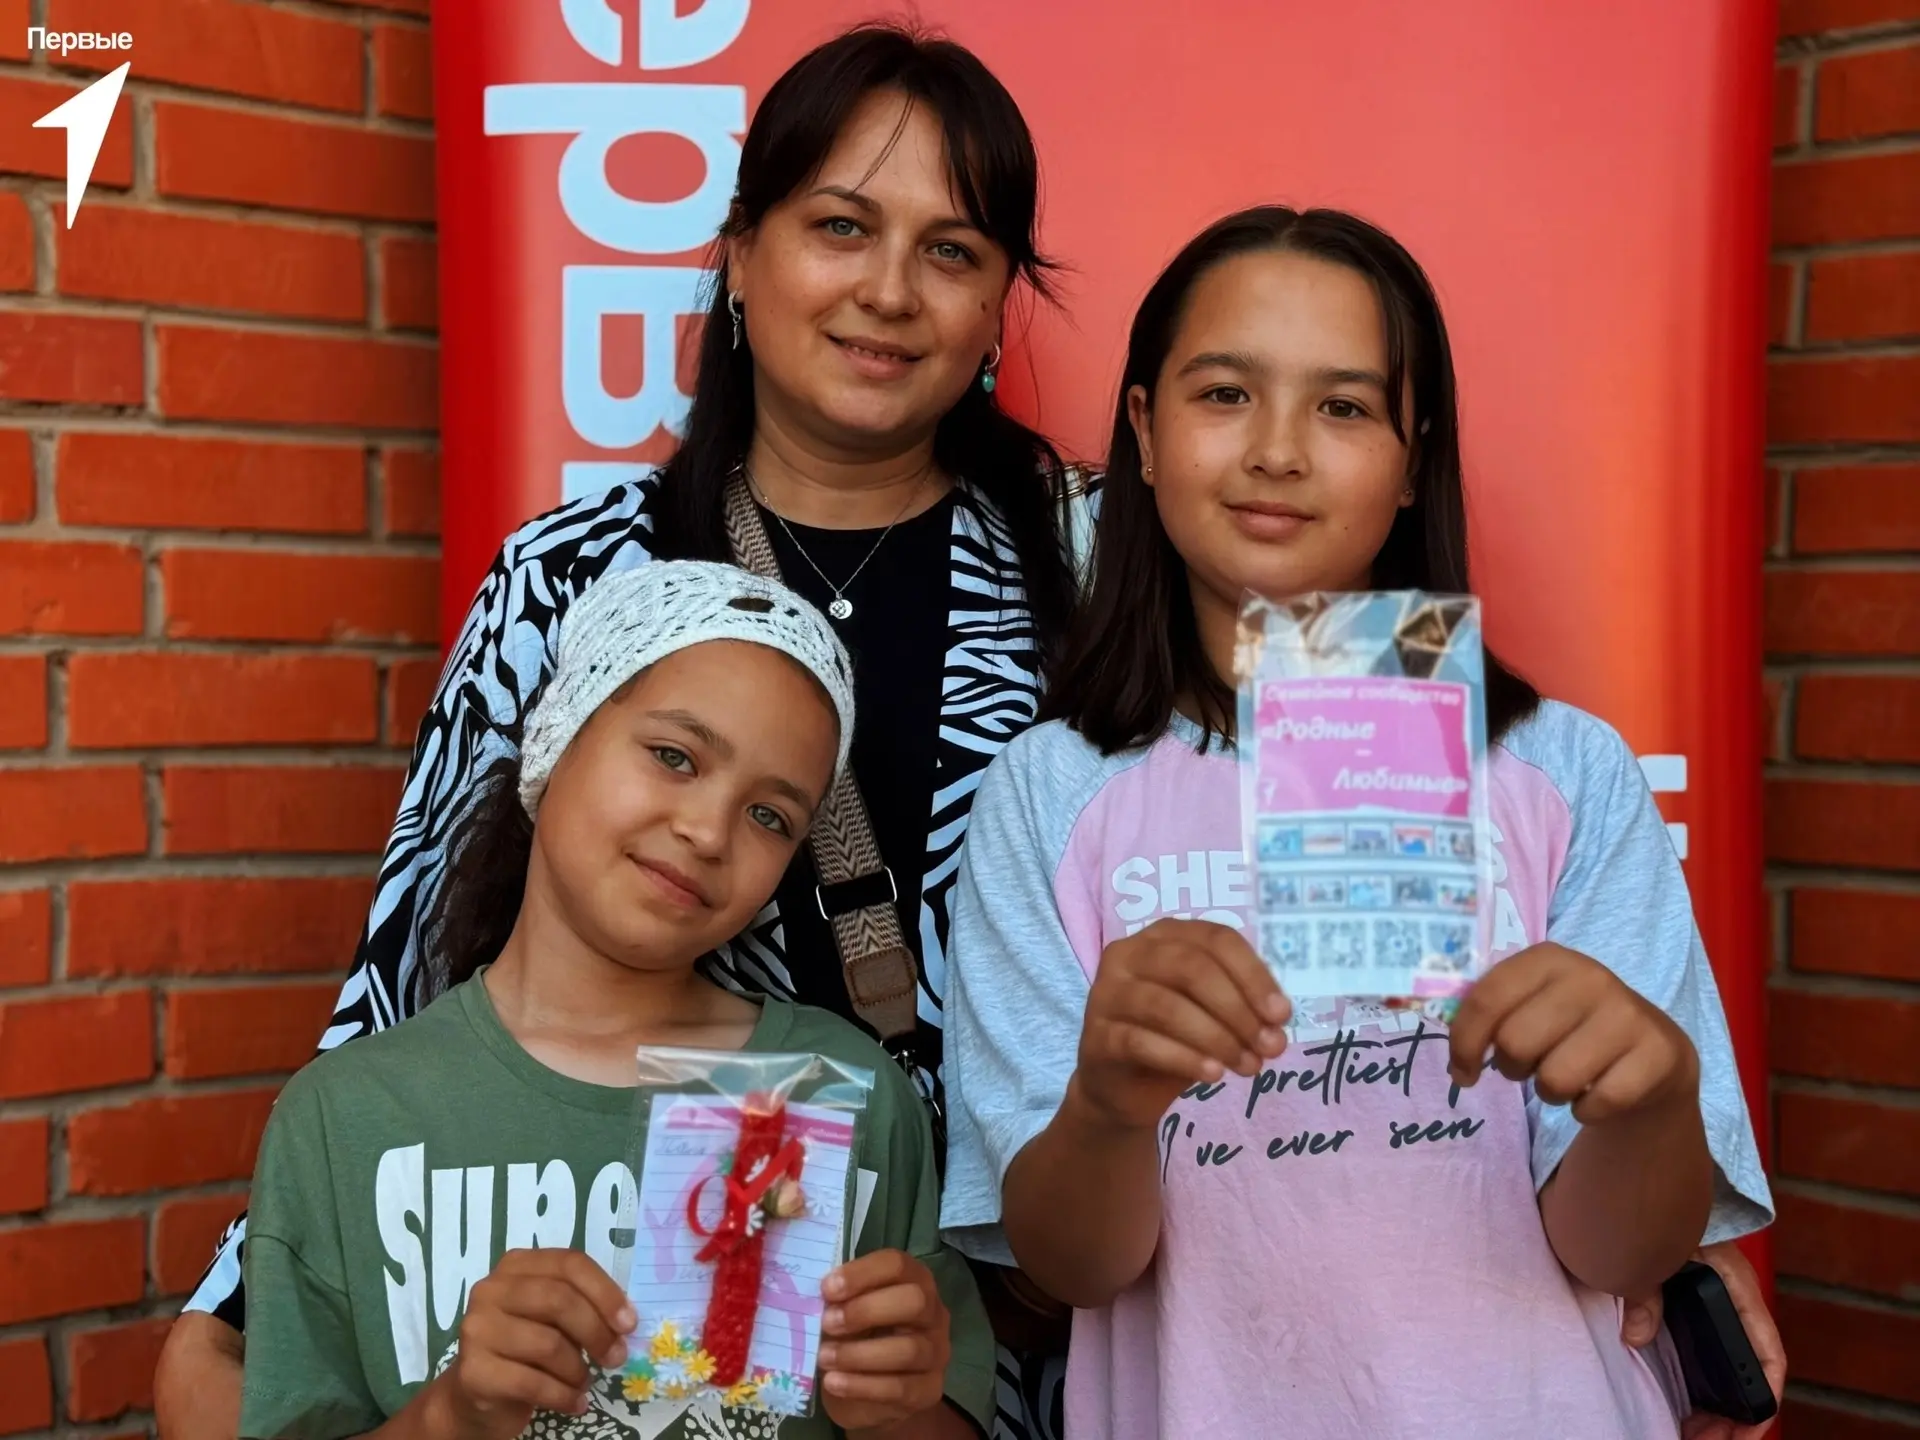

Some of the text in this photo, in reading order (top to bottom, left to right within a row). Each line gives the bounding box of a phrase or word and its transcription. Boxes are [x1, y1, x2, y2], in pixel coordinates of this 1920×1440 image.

[1112, 850, 1251, 921] SHE
[1245, 1022, 1450, 1119] prettiest
[1161, 1112, 1485, 1184] I've ever seen
[375, 1142, 641, 1386] Supe
